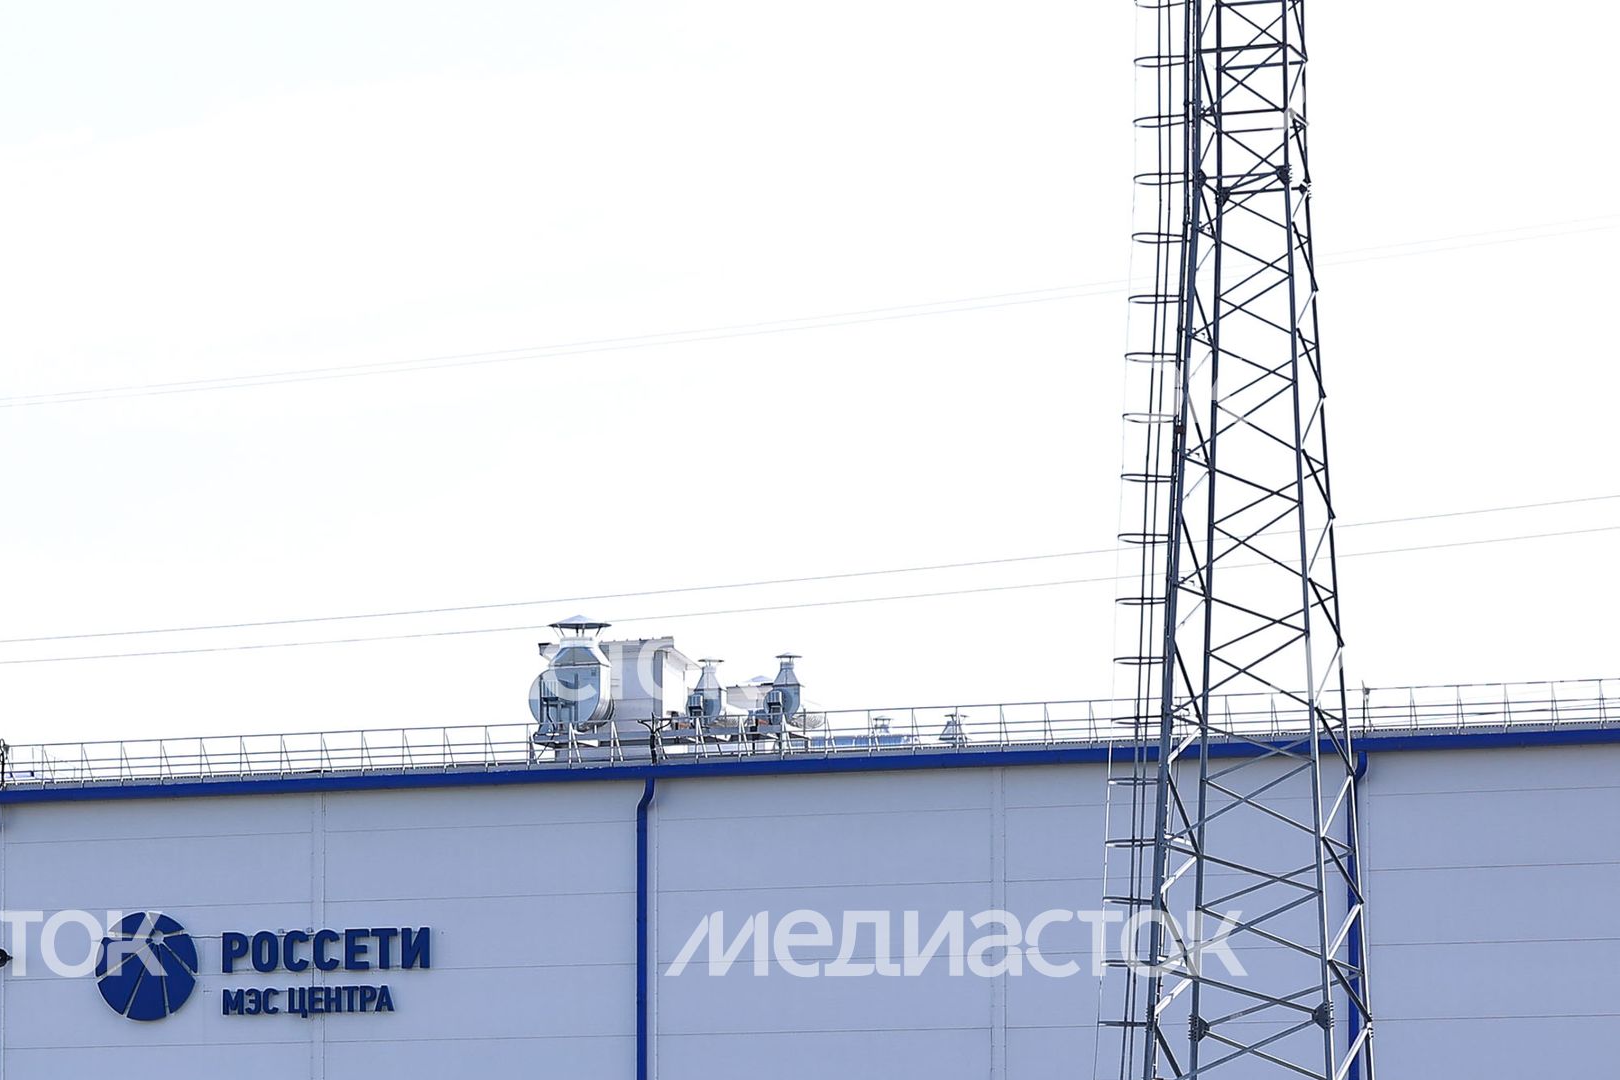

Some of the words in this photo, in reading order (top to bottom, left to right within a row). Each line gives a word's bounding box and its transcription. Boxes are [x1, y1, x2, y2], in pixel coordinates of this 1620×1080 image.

[222, 927, 431, 973] РОССЕТИ
[222, 988, 279, 1015] МЭС
[288, 985, 394, 1018] ЦЕНТРА
